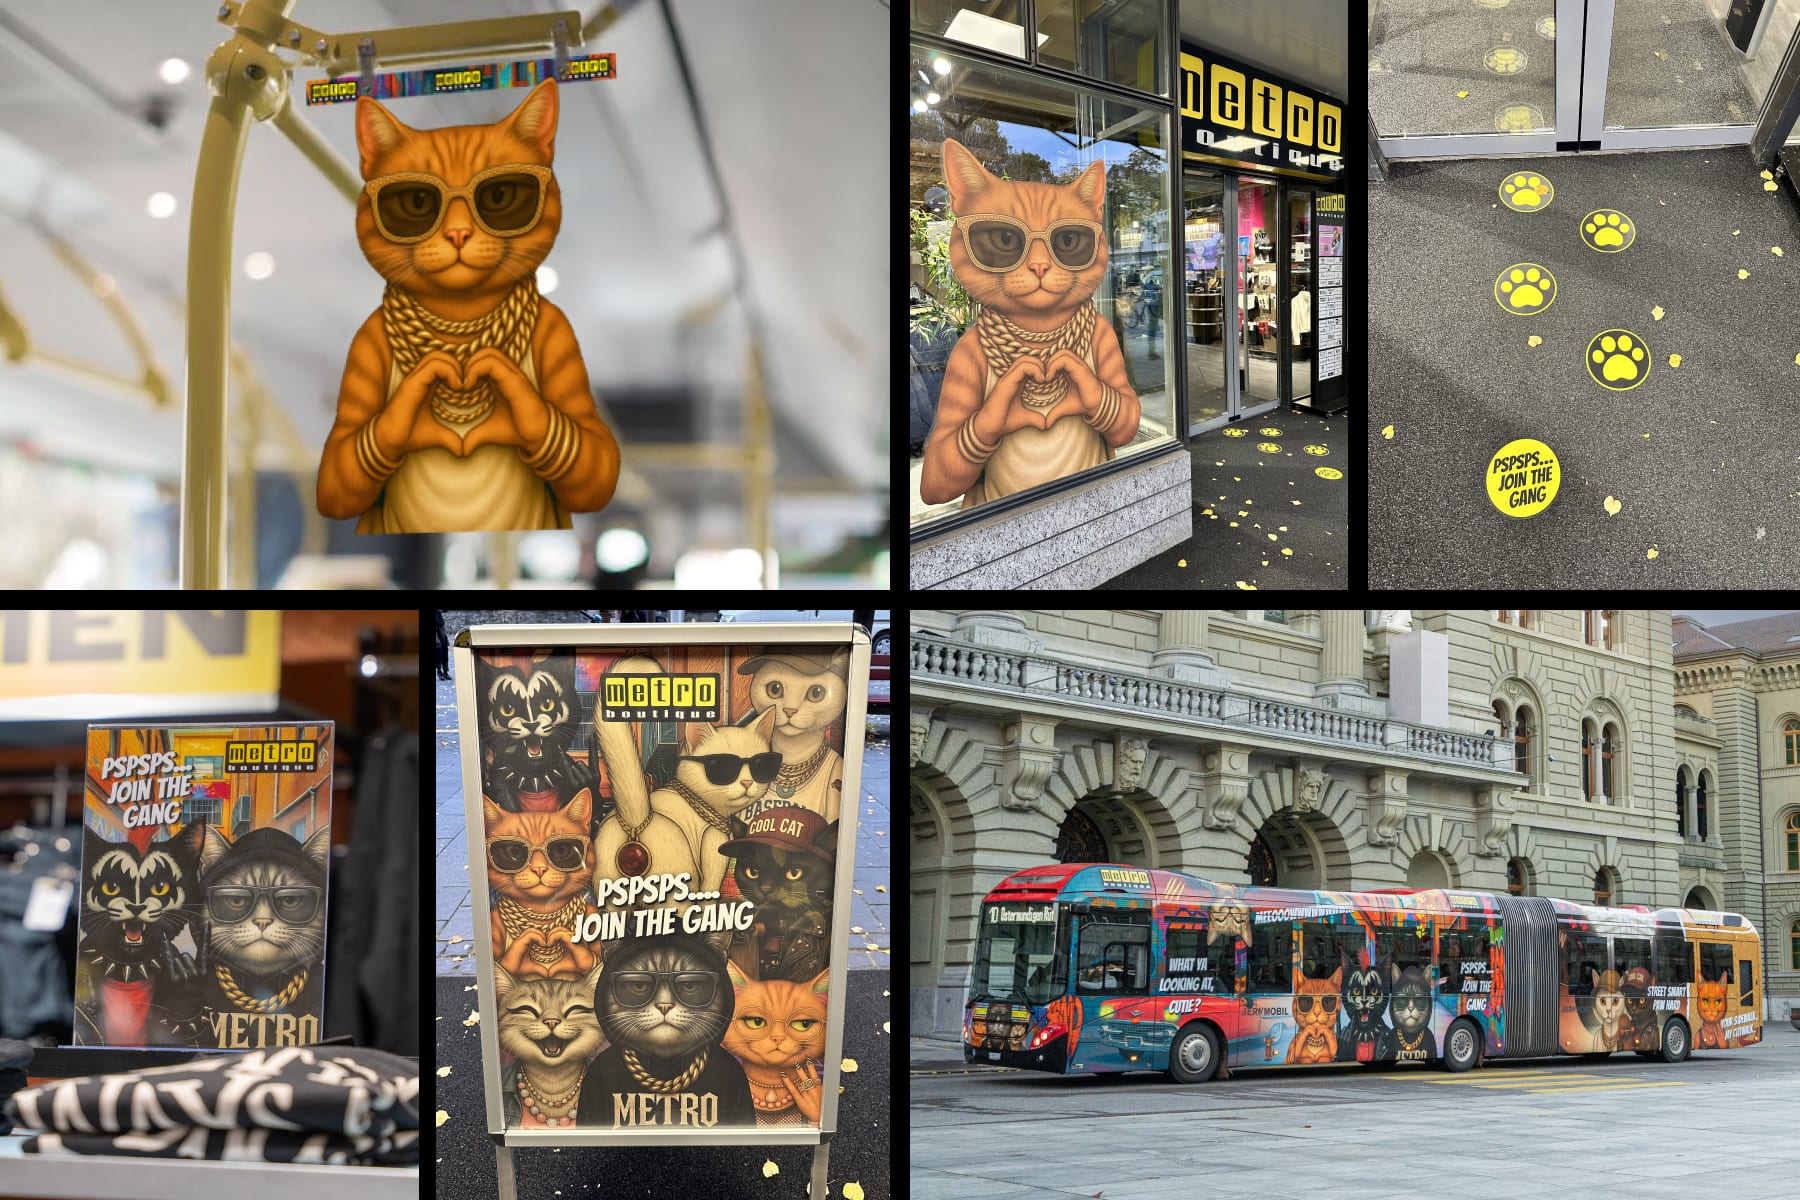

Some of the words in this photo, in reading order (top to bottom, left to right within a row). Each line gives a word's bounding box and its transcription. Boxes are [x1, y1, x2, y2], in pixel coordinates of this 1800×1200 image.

[1493, 451, 1553, 474] PSPSPS...
[1498, 471, 1527, 491] JOIN
[1531, 466, 1552, 485] THE
[1509, 485, 1546, 508] GANG
[606, 679, 713, 704] metro
[606, 710, 716, 719] boutique
[230, 744, 312, 762] metro
[102, 751, 193, 780] PSPSPS...
[228, 764, 314, 772] boutique
[108, 778, 151, 804] JOIN
[158, 775, 192, 799] THE
[123, 802, 181, 828] GANG
[749, 818, 776, 835] COOL
[779, 818, 804, 837] CAT
[1102, 870, 1149, 883] metro
[598, 873, 721, 907] PSPSPS....
[571, 911, 627, 943] JOIN
[634, 907, 679, 937] THE
[682, 901, 754, 935] GANG
[989, 907, 999, 923] 10
[1169, 957, 1195, 971] WHAT
[1196, 957, 1208, 971] YA
[1159, 976, 1200, 992] LOOKING
[1200, 976, 1214, 992] AT,
[1461, 980, 1478, 992] JOIN
[1479, 980, 1492, 992] THE
[1647, 985, 1667, 997] STREET
[1466, 998, 1487, 1011] GANG
[612, 1092, 719, 1130] METRO
